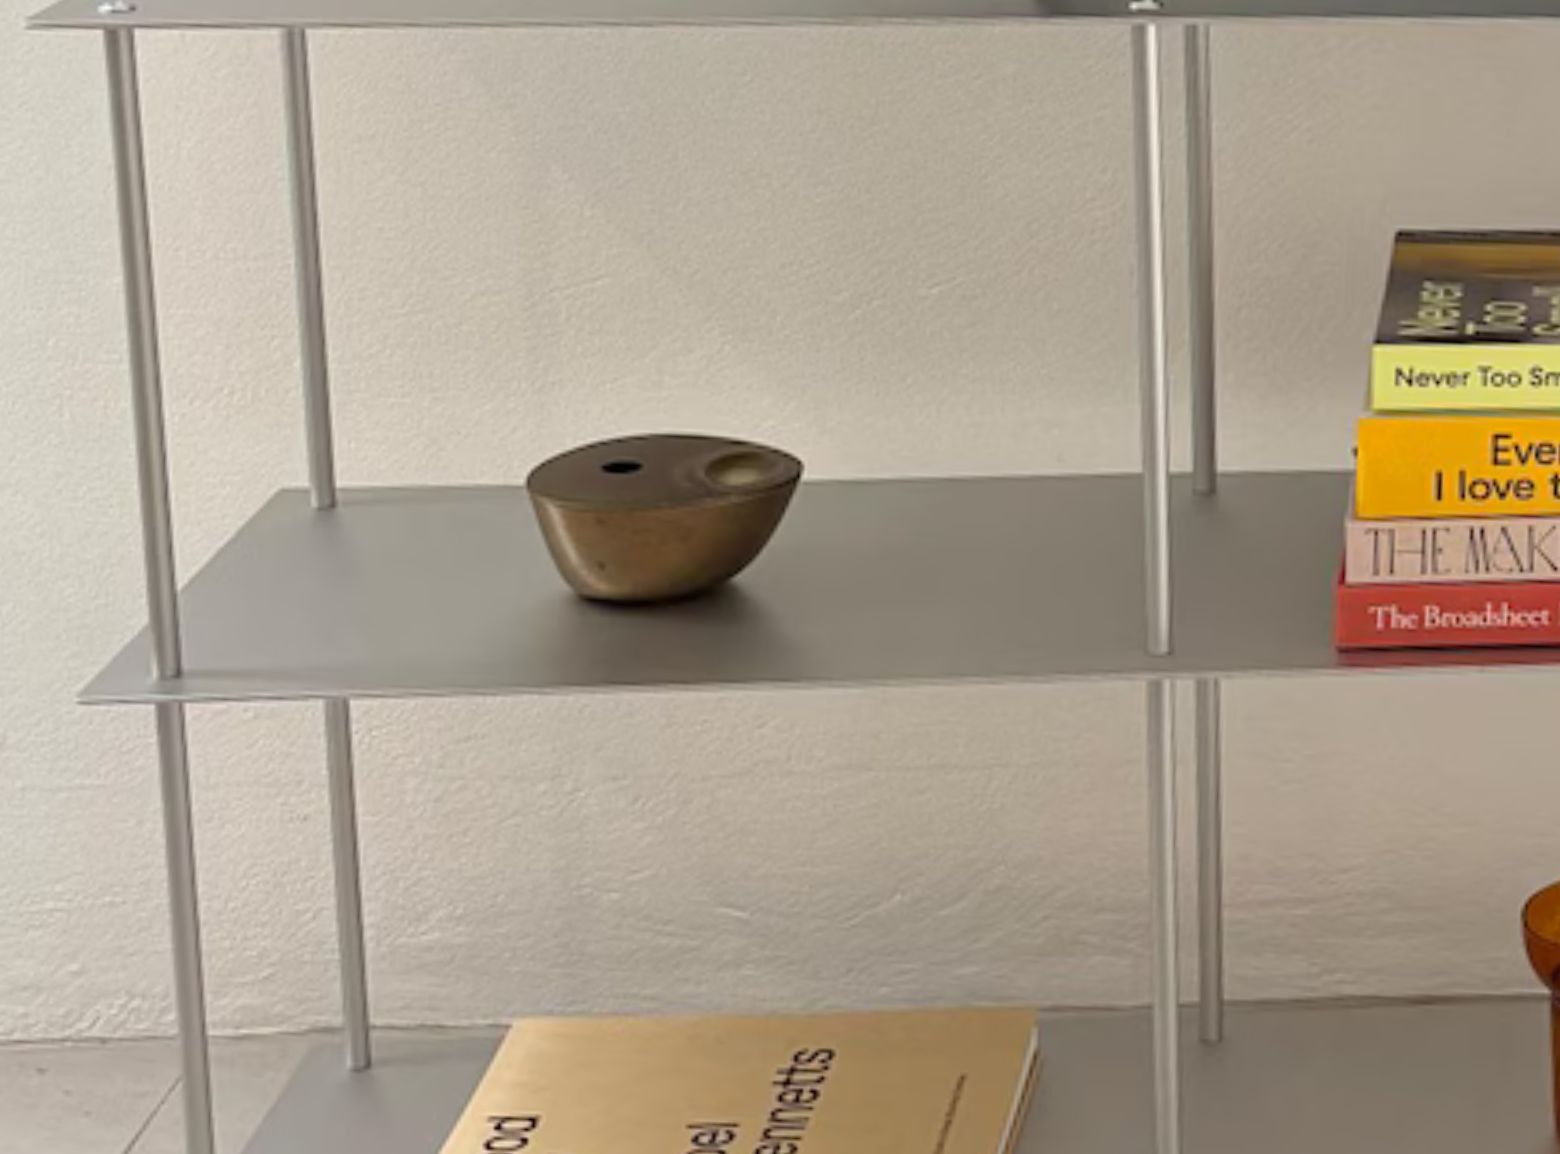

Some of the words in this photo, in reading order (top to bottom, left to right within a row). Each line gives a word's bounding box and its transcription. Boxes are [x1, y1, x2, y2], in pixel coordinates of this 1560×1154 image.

[1397, 280, 1463, 336] Never
[1465, 299, 1528, 336] Too
[1394, 367, 1470, 388] Never
[1477, 366, 1522, 388] Too
[1434, 470, 1444, 502] I
[1458, 469, 1535, 501] love
[1365, 526, 1451, 576] THE
[1367, 604, 1418, 631] The
[1423, 601, 1550, 629] Broadsheet
